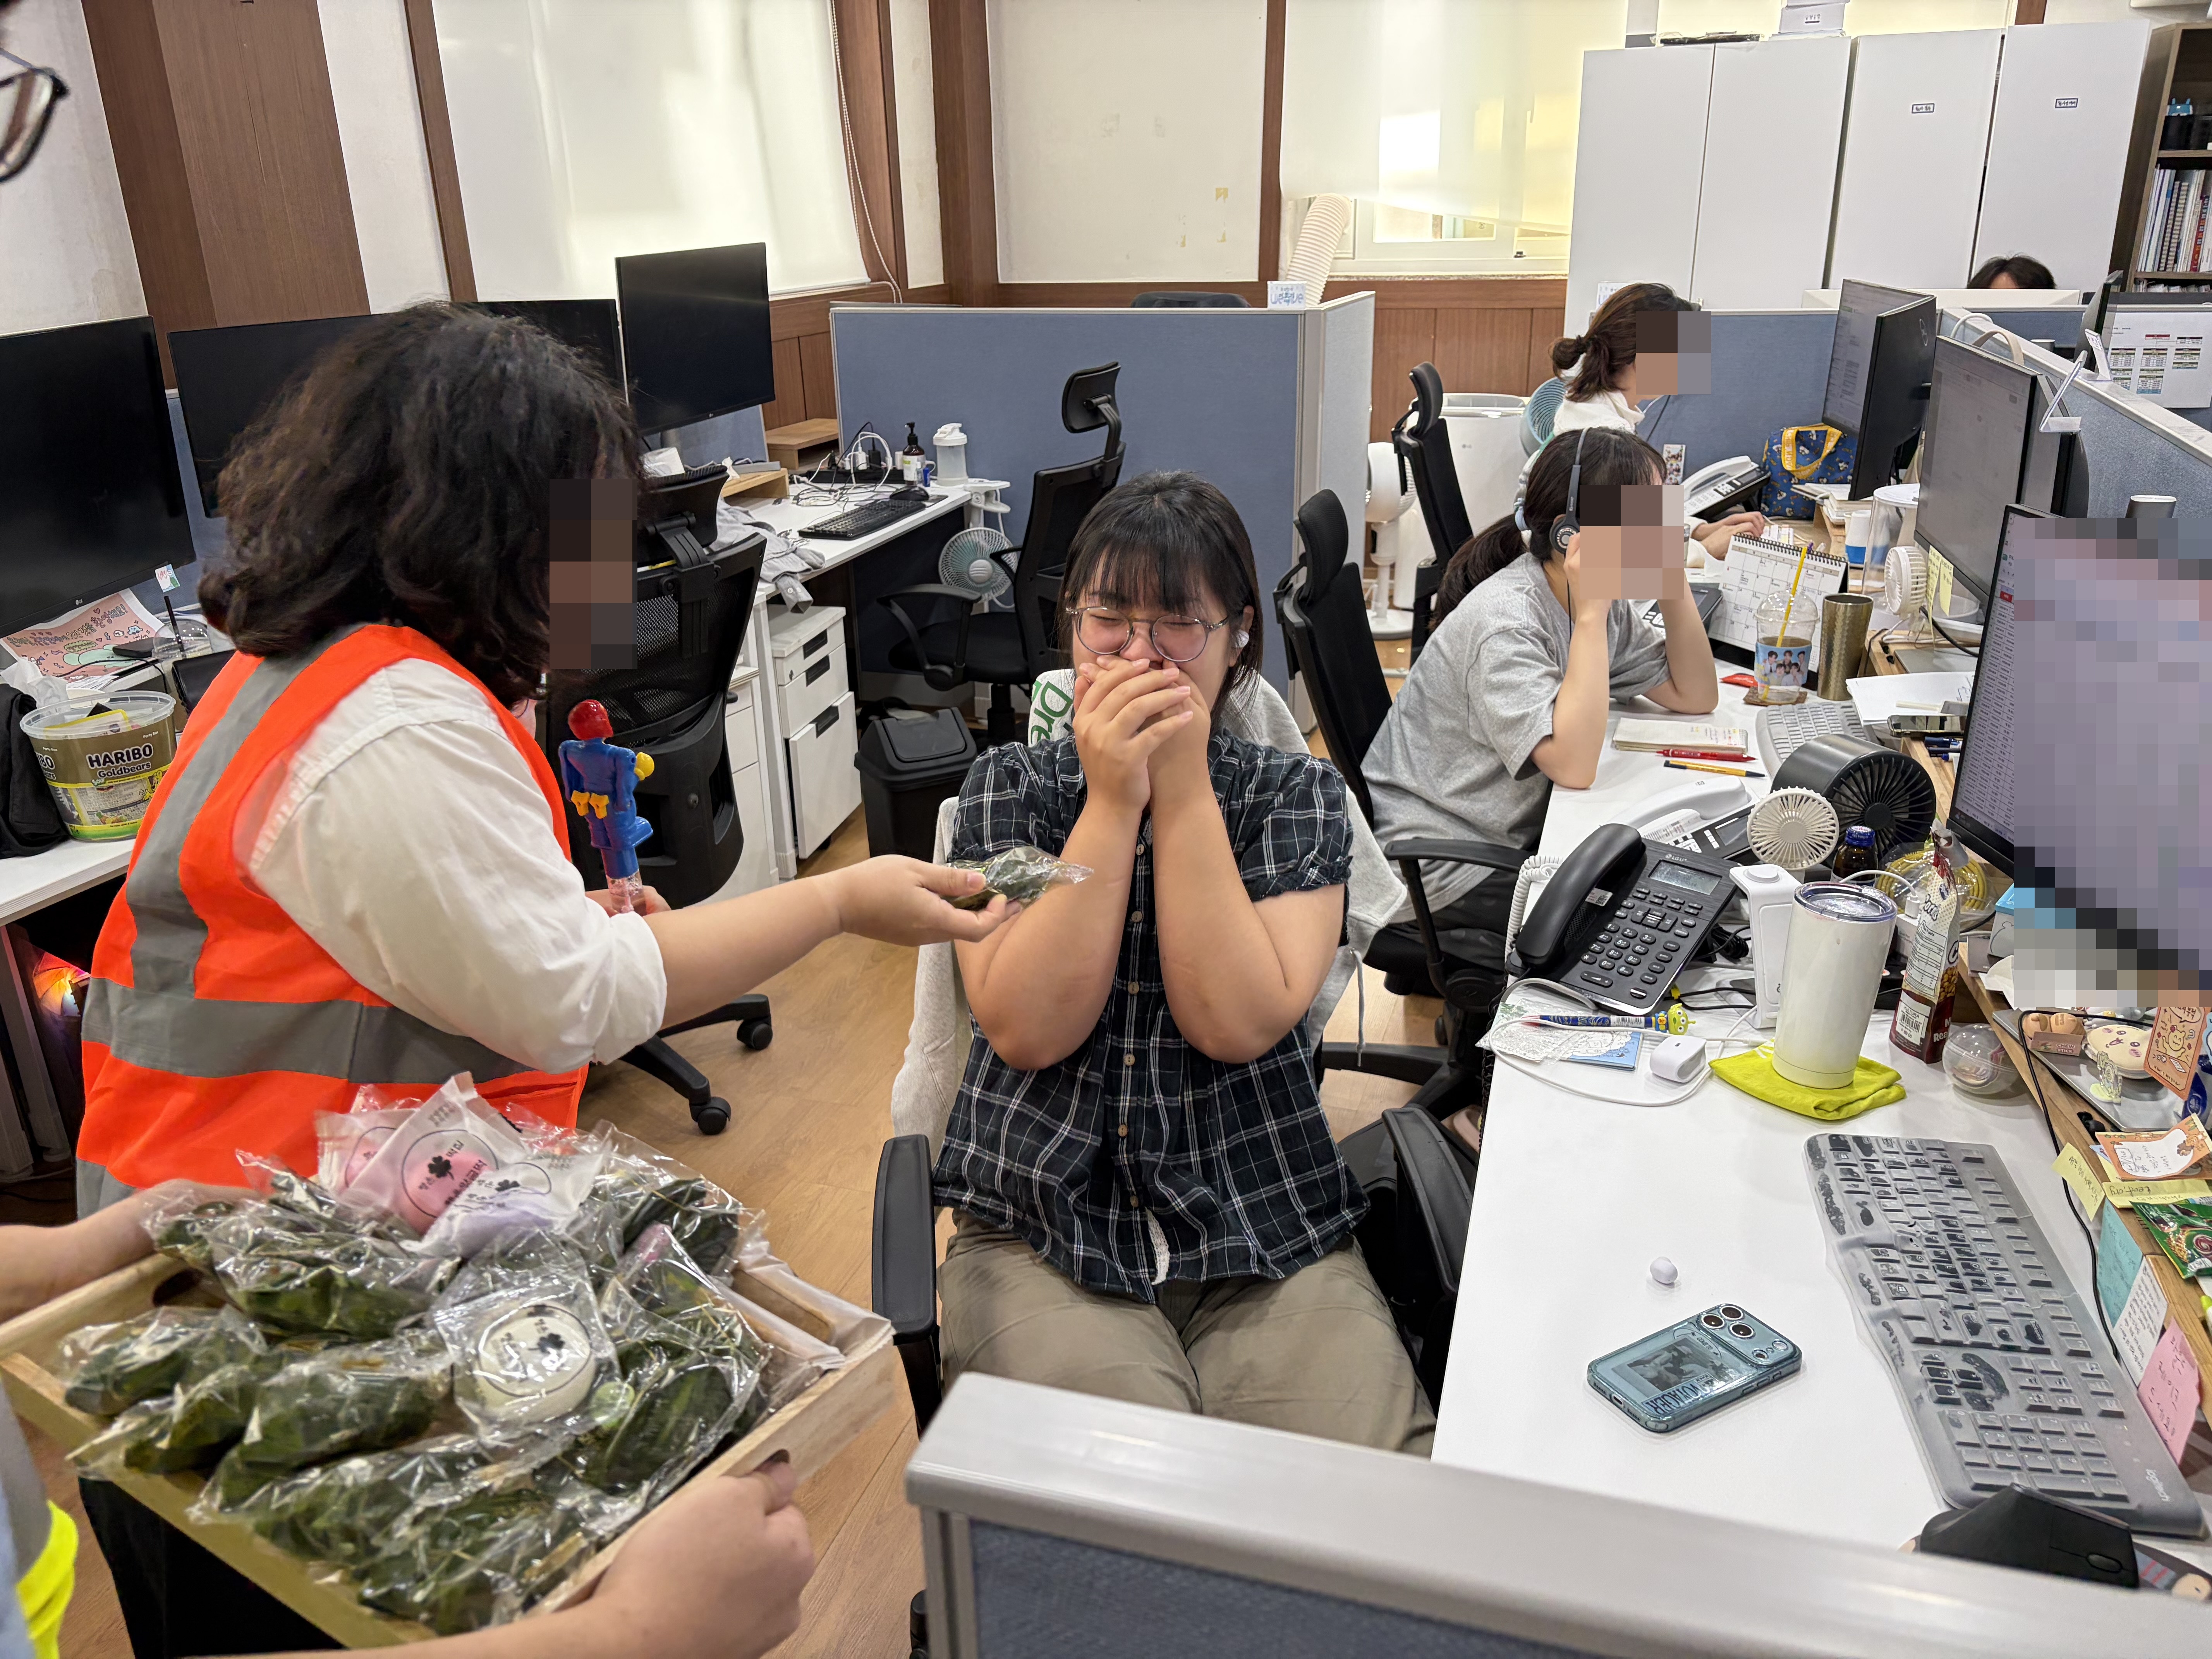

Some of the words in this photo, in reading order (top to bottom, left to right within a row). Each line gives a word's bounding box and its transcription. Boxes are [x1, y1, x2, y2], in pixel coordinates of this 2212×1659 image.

[91, 604, 129, 628] 환영해요!
[86, 743, 153, 768] HARIBO
[98, 762, 151, 779] Goldbears
[1933, 1031, 1949, 1042] Rea
[1645, 1383, 1704, 1416] VOYAGER
[2144, 1468, 2171, 1502] logitech
